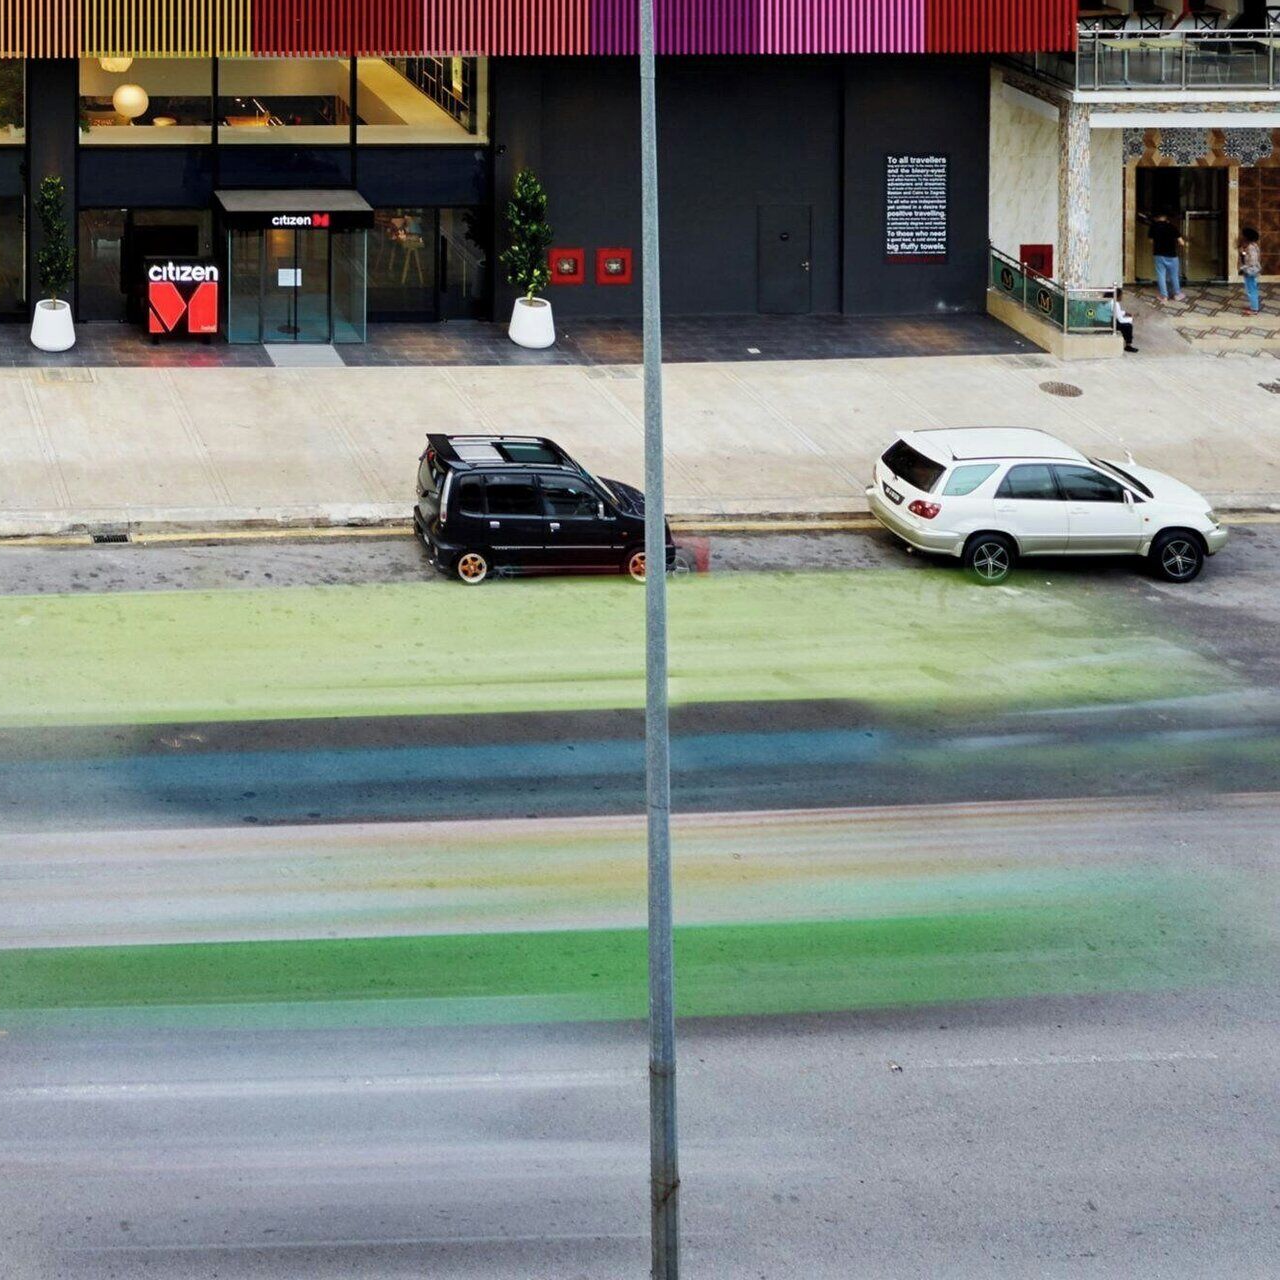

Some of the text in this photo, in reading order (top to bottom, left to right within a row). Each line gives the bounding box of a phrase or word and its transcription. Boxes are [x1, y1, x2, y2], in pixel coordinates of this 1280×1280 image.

[887, 156, 946, 164] To all travellers
[272, 215, 311, 225] citizen
[887, 243, 899, 251] big
[900, 243, 918, 251] fluffy
[149, 261, 218, 281] citizen
[149, 282, 218, 332] M
